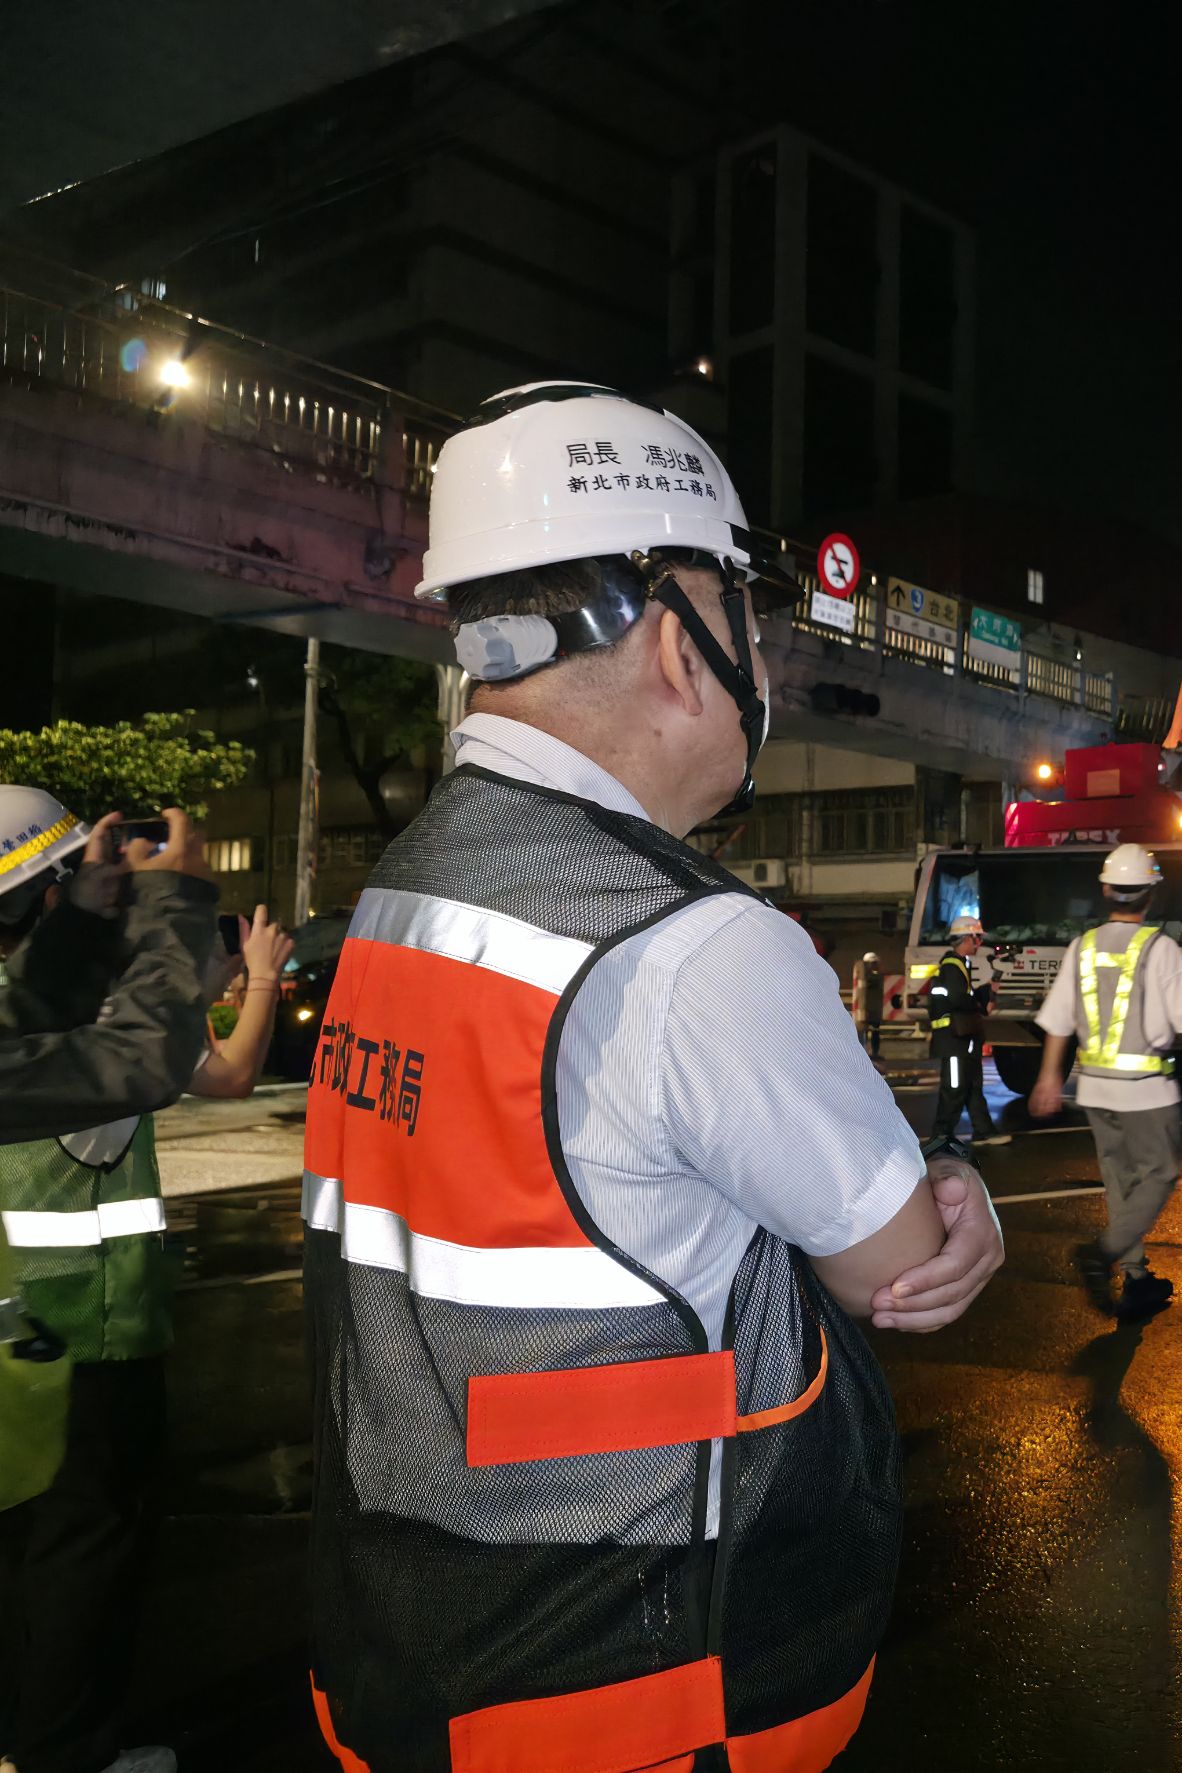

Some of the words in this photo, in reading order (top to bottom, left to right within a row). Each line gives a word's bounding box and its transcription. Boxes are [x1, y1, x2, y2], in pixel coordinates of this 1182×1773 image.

[566, 441, 621, 467] 局長
[643, 445, 705, 475] 馮兆麟
[566, 473, 717, 502] 新北市政府工務局
[929, 599, 953, 621] 台北
